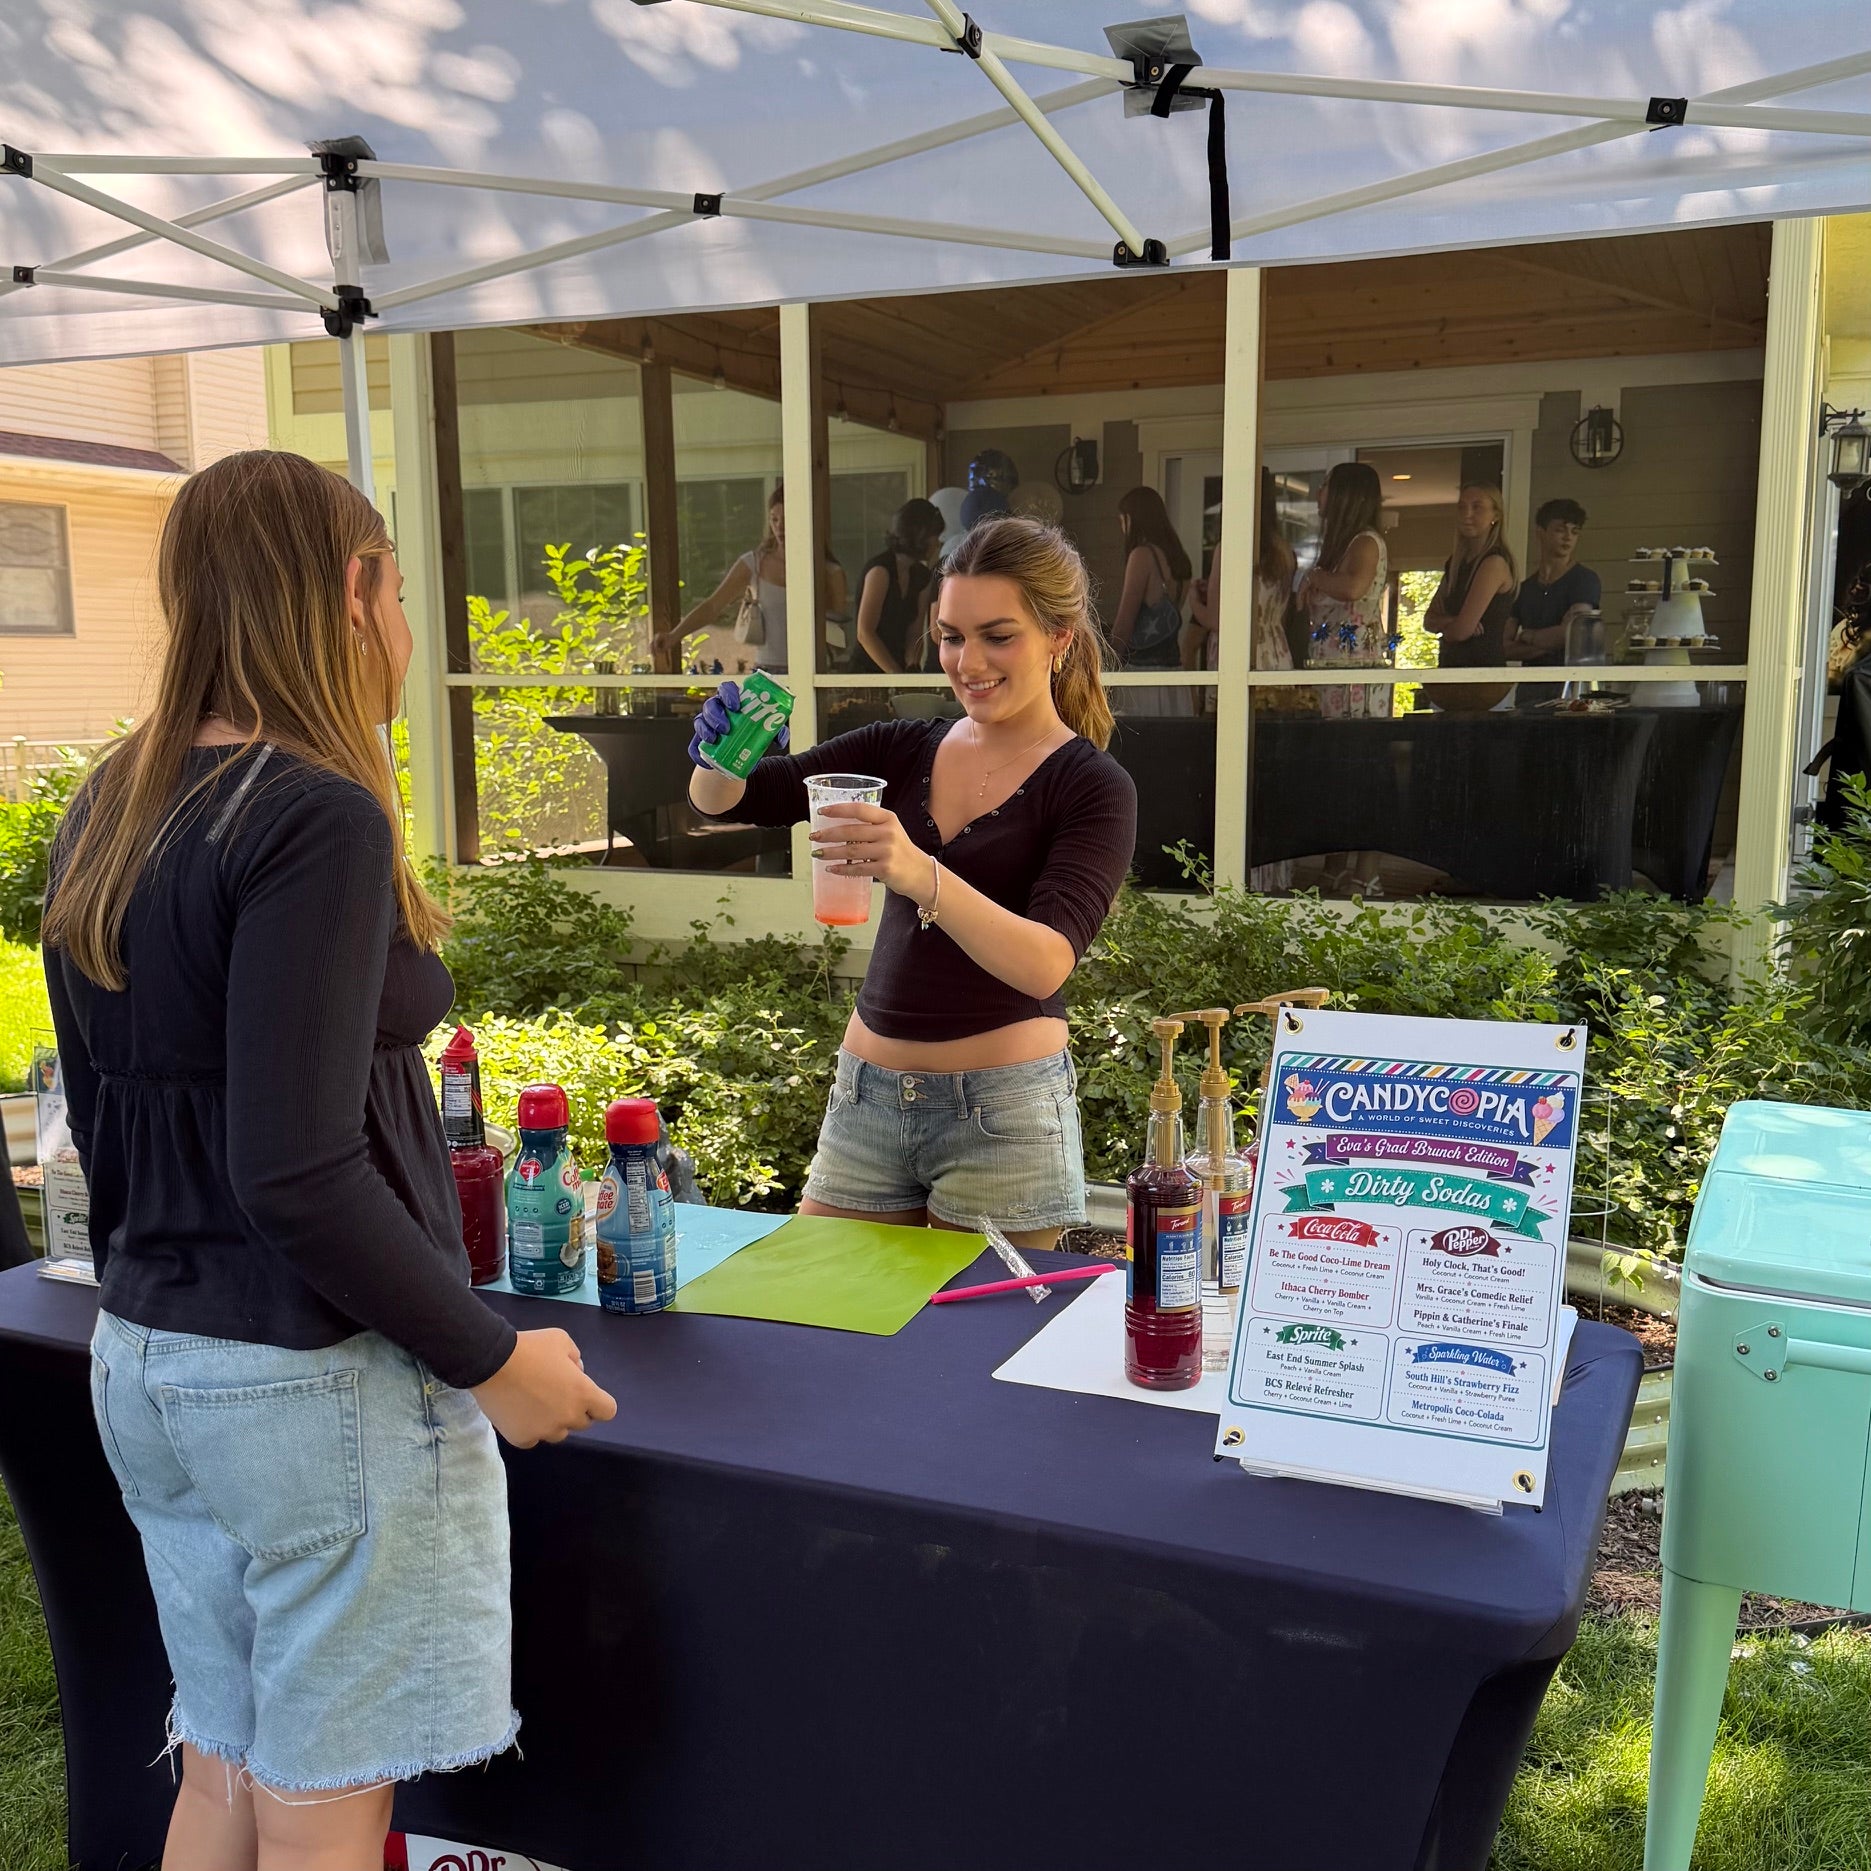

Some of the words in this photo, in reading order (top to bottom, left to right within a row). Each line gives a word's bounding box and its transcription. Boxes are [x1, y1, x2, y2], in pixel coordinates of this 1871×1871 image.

[737, 683, 786, 732] rite
[1325, 1081, 1530, 1138] CANDYCOPIA
[1368, 1114, 1400, 1122] WORLD
[1418, 1117, 1449, 1125] SWEET
[1452, 1119, 1515, 1137] DISCOVERIES
[1336, 1136, 1372, 1152] Eva's
[1375, 1138, 1412, 1157] Grad
[1412, 1140, 1461, 1163] Brunch
[1465, 1146, 1509, 1167] Edition
[599, 1190, 614, 1202] ffee
[1345, 1171, 1415, 1207] Dirty
[1422, 1178, 1492, 1210] Sodas
[1304, 1218, 1363, 1241] Coca-Cola
[1460, 1228, 1475, 1240] Dr
[1448, 1230, 1485, 1251] Pepper
[1269, 1248, 1279, 1258] Be
[1282, 1250, 1296, 1259] The
[1298, 1252, 1318, 1262] Good
[1320, 1254, 1361, 1267] Coco-Lime
[1363, 1259, 1391, 1271] Dream
[1422, 1257, 1442, 1269] Holy
[1443, 1260, 1470, 1271] Clock,
[1472, 1263, 1498, 1274] That's
[1500, 1266, 1526, 1277] Good!
[1162, 1272, 1184, 1280] Calories
[1272, 1261, 1295, 1269] Coconut
[1302, 1264, 1318, 1272] Fresh
[1340, 1269, 1364, 1278] Coconut
[1365, 1272, 1385, 1280] Cream
[1432, 1269, 1457, 1277] Coconut
[1464, 1273, 1489, 1282] Coconut
[1281, 1281, 1306, 1293] Ithaca
[1308, 1285, 1337, 1298] Cherry
[1338, 1288, 1370, 1300] Bomber
[1416, 1283, 1435, 1293] Mrs.
[1437, 1286, 1469, 1297] Grace's
[1470, 1289, 1507, 1302] Comedic
[1508, 1294, 1534, 1304] Relief
[1274, 1293, 1295, 1302] Cherry
[1301, 1296, 1320, 1304] Vanilla
[1326, 1299, 1345, 1307] Vanilla
[1347, 1302, 1366, 1310] Cream
[1303, 1304, 1323, 1314] Cherry
[1333, 1308, 1344, 1316] Top
[1415, 1293, 1433, 1301] Vanilla
[1440, 1296, 1466, 1305] Coconut
[1466, 1299, 1487, 1307] Cream
[1493, 1302, 1510, 1310] Fresh
[1511, 1304, 1526, 1312] Lime
[1413, 1309, 1440, 1322] Pippin
[1442, 1313, 1449, 1322] &
[1452, 1315, 1500, 1328] Catherine's
[1502, 1320, 1528, 1332] Finale
[1290, 1326, 1332, 1345] Sprite
[1442, 1324, 1461, 1333] Vanilla
[1462, 1327, 1482, 1335] Cream
[1489, 1330, 1505, 1338] Fresh
[1507, 1332, 1521, 1340] Lime
[1266, 1350, 1284, 1361] East
[1287, 1353, 1303, 1363] End
[1304, 1355, 1338, 1369] Summer
[1339, 1360, 1365, 1372] Splash
[1429, 1346, 1471, 1364] Sparkling
[1472, 1351, 1500, 1367] Water
[1280, 1363, 1297, 1371] Peach
[1304, 1367, 1322, 1375] Vanilla
[1265, 1377, 1283, 1388] BCS
[1285, 1382, 1312, 1393] Relevé
[1314, 1384, 1354, 1399] Refresher
[1405, 1370, 1429, 1381] South
[1431, 1373, 1452, 1385] Hill's
[1454, 1377, 1501, 1393] Strawberry
[1503, 1383, 1520, 1394] Fizz
[1408, 1382, 1432, 1391] Coconut
[1440, 1386, 1458, 1395] Vanilla
[1465, 1390, 1497, 1401] Strawberry
[1263, 1390, 1282, 1399] Cherry
[1289, 1394, 1313, 1402] Coconut
[1313, 1397, 1332, 1405] Cream
[1338, 1401, 1352, 1409] Lime
[1411, 1400, 1453, 1414] Metropolis
[1455, 1406, 1504, 1421] Coco-Colada
[1401, 1411, 1425, 1420] Coconut
[1431, 1414, 1447, 1423] Fresh
[1448, 1417, 1462, 1425] Lime
[1468, 1420, 1493, 1430] Coconut
[1494, 1423, 1513, 1432] Cream
